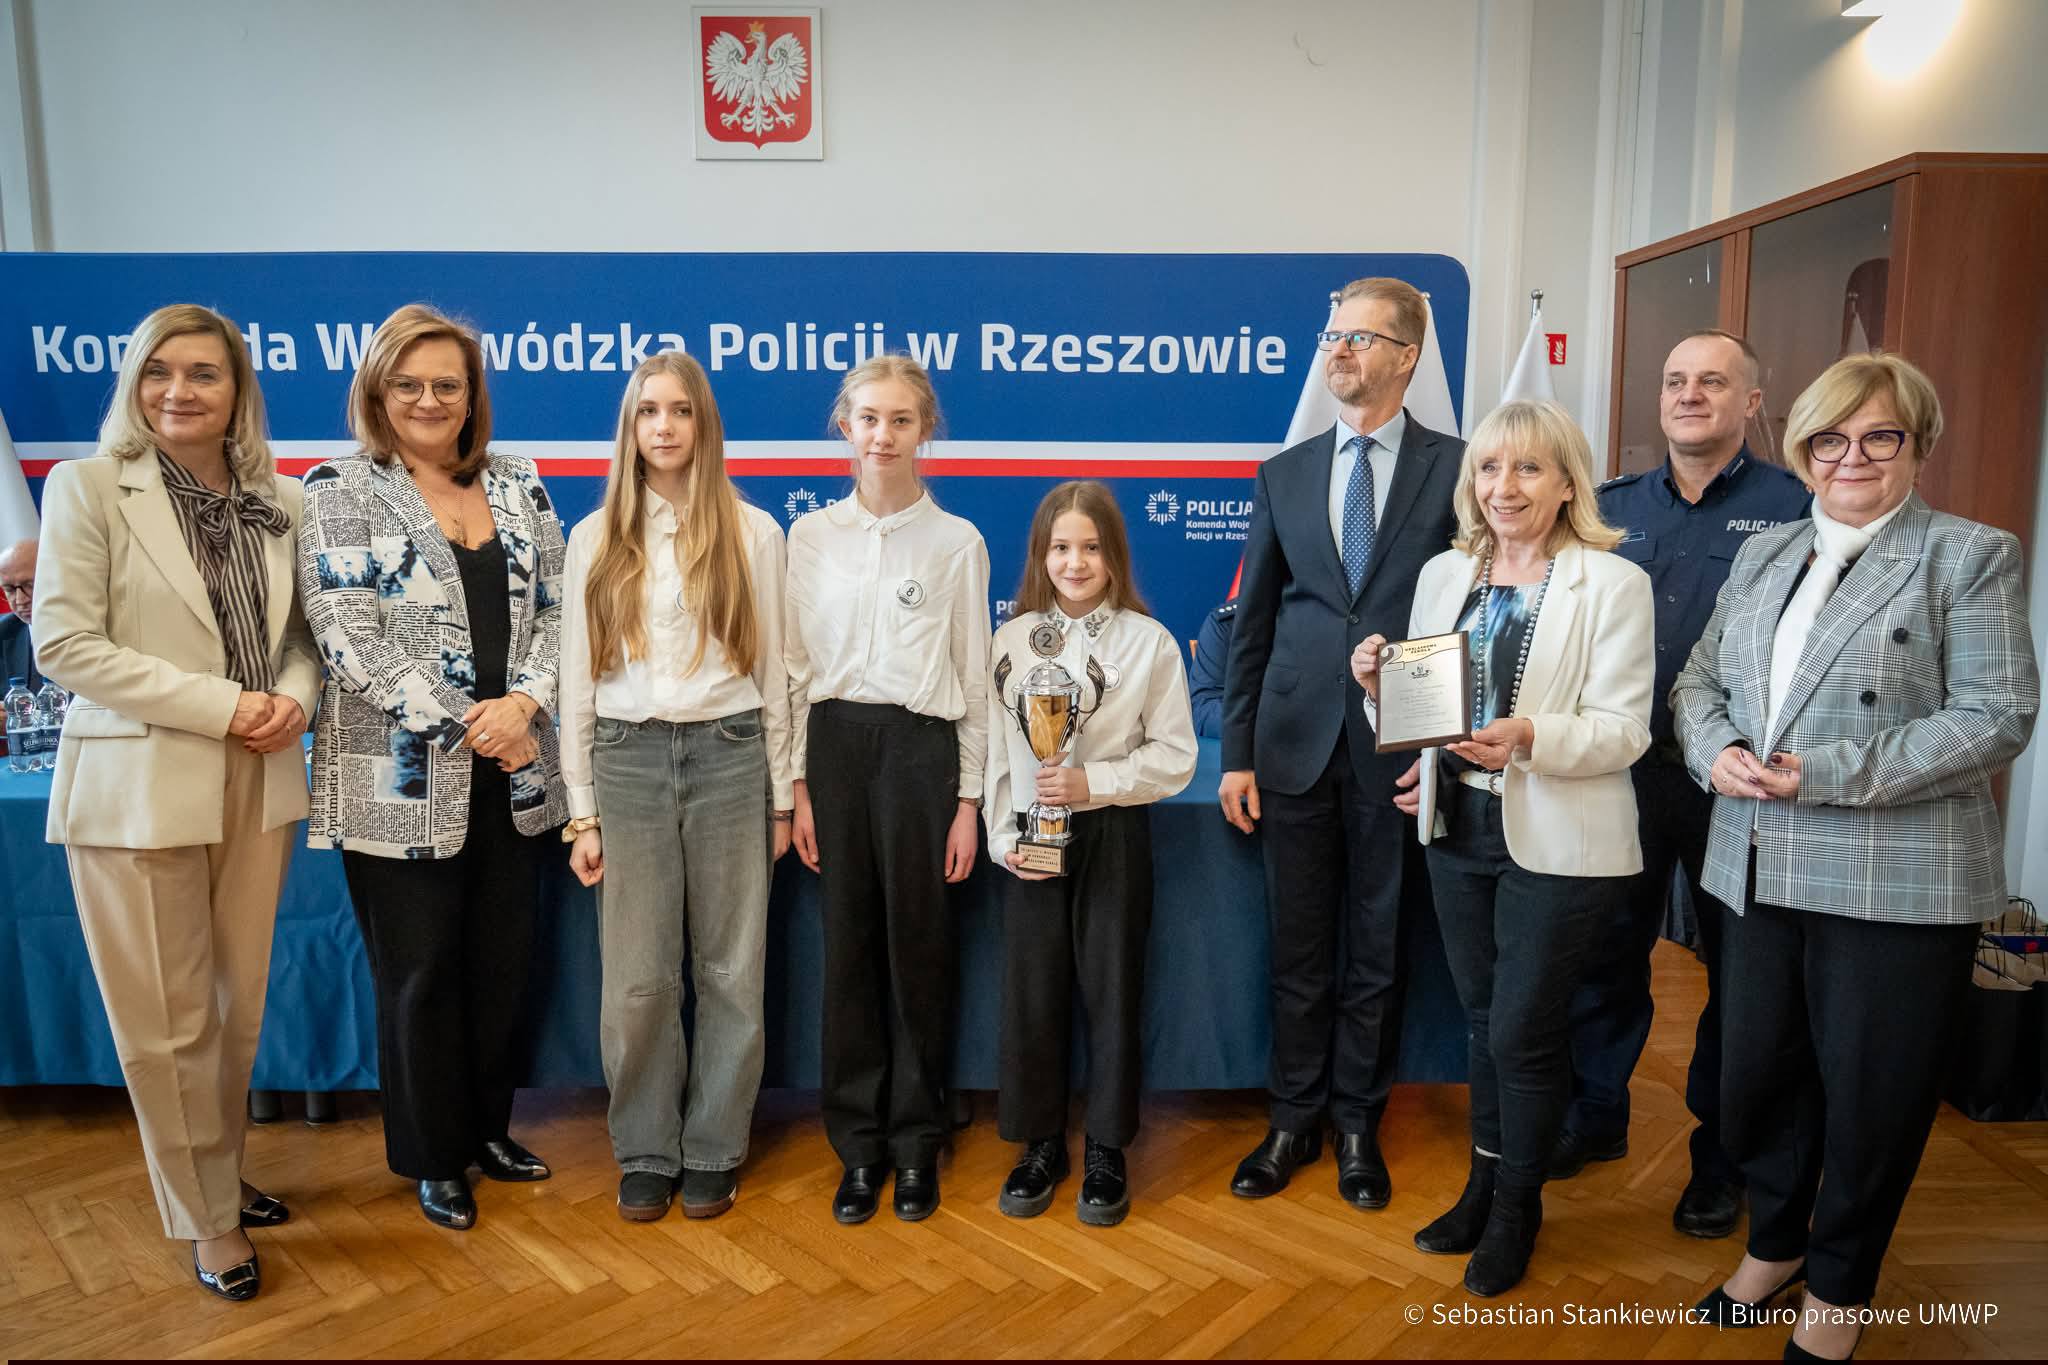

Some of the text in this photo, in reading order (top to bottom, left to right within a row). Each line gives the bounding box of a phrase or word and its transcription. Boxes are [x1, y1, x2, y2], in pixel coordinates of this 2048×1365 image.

[709, 322, 885, 372] Policji
[907, 332, 959, 371] w
[981, 323, 1287, 374] Rzeszowie
[304, 480, 337, 494] uture
[1186, 500, 1253, 516] POLICJA
[1186, 520, 1227, 529] Komenda
[1186, 531, 1213, 541] Policji
[906, 586, 915, 597] 8
[1042, 632, 1053, 648] 2
[416, 667, 437, 687] NOW
[338, 727, 350, 753] TRUTH
[326, 722, 341, 838] Optimistic Future
